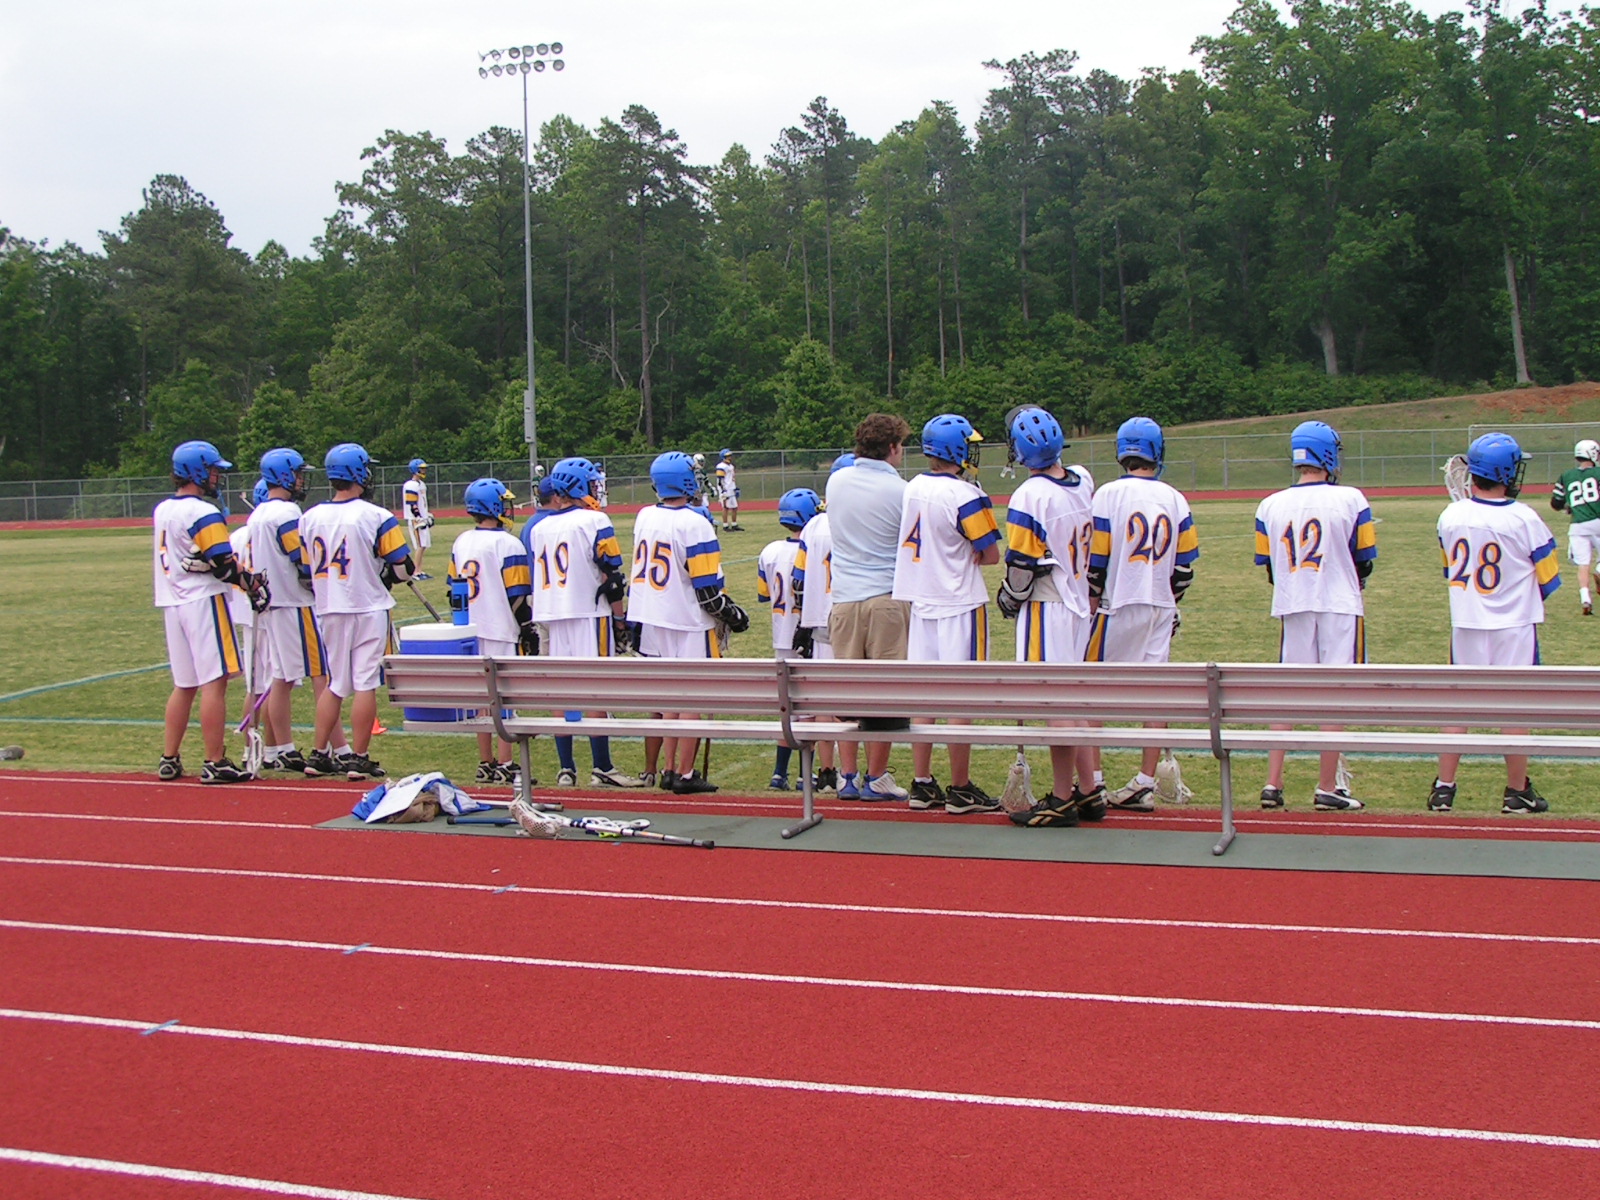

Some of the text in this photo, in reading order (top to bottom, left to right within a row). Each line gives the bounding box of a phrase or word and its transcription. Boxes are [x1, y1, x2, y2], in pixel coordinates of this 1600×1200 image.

[1568, 477, 1599, 507] 28
[313, 534, 351, 580] 24
[901, 510, 921, 562] 4
[1126, 511, 1173, 565] 20
[1280, 518, 1323, 573] 12
[461, 559, 481, 604] 3
[537, 543, 568, 590] 19
[632, 538, 672, 591] 25
[1449, 537, 1502, 595] 28
